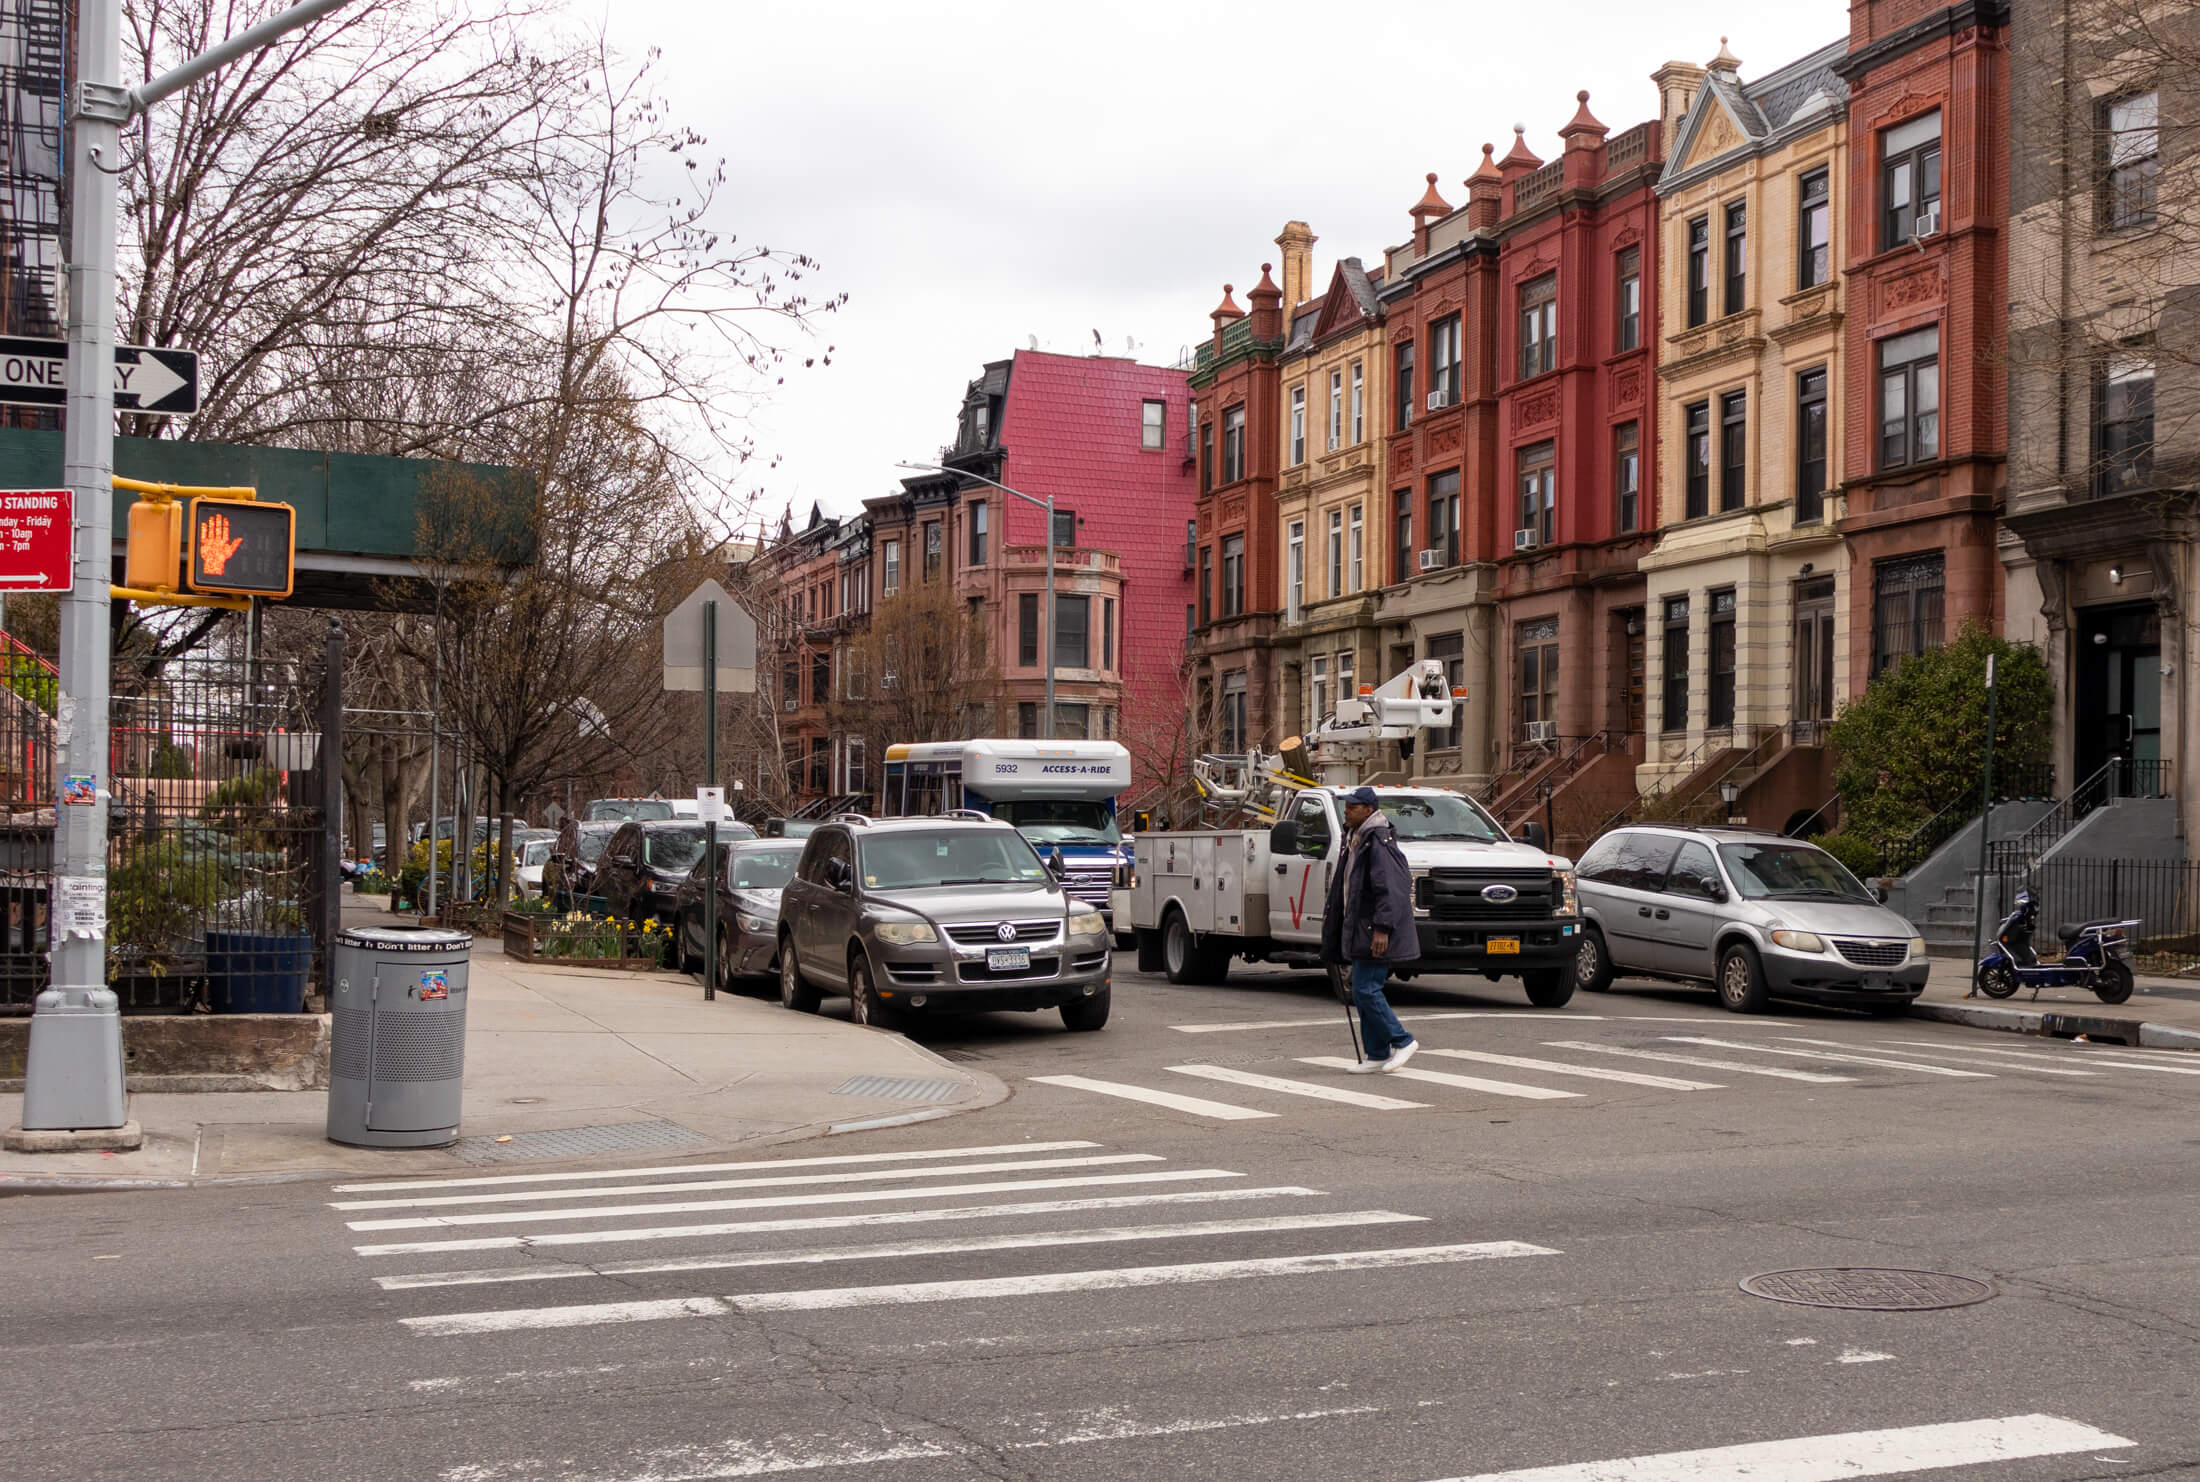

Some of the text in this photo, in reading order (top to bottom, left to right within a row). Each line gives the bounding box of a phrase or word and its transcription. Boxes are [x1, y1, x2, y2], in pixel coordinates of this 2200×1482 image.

[6, 358, 64, 385] ONE
[4, 496, 58, 510] STANDING
[26, 515, 52, 528] Friday
[13, 541, 30, 552] 7pm
[995, 764, 1111, 774] 5932 ACCESS-A-RIDE
[377, 942, 403, 950] Don't
[408, 943, 431, 951] litter
[446, 942, 464, 951] Don't
